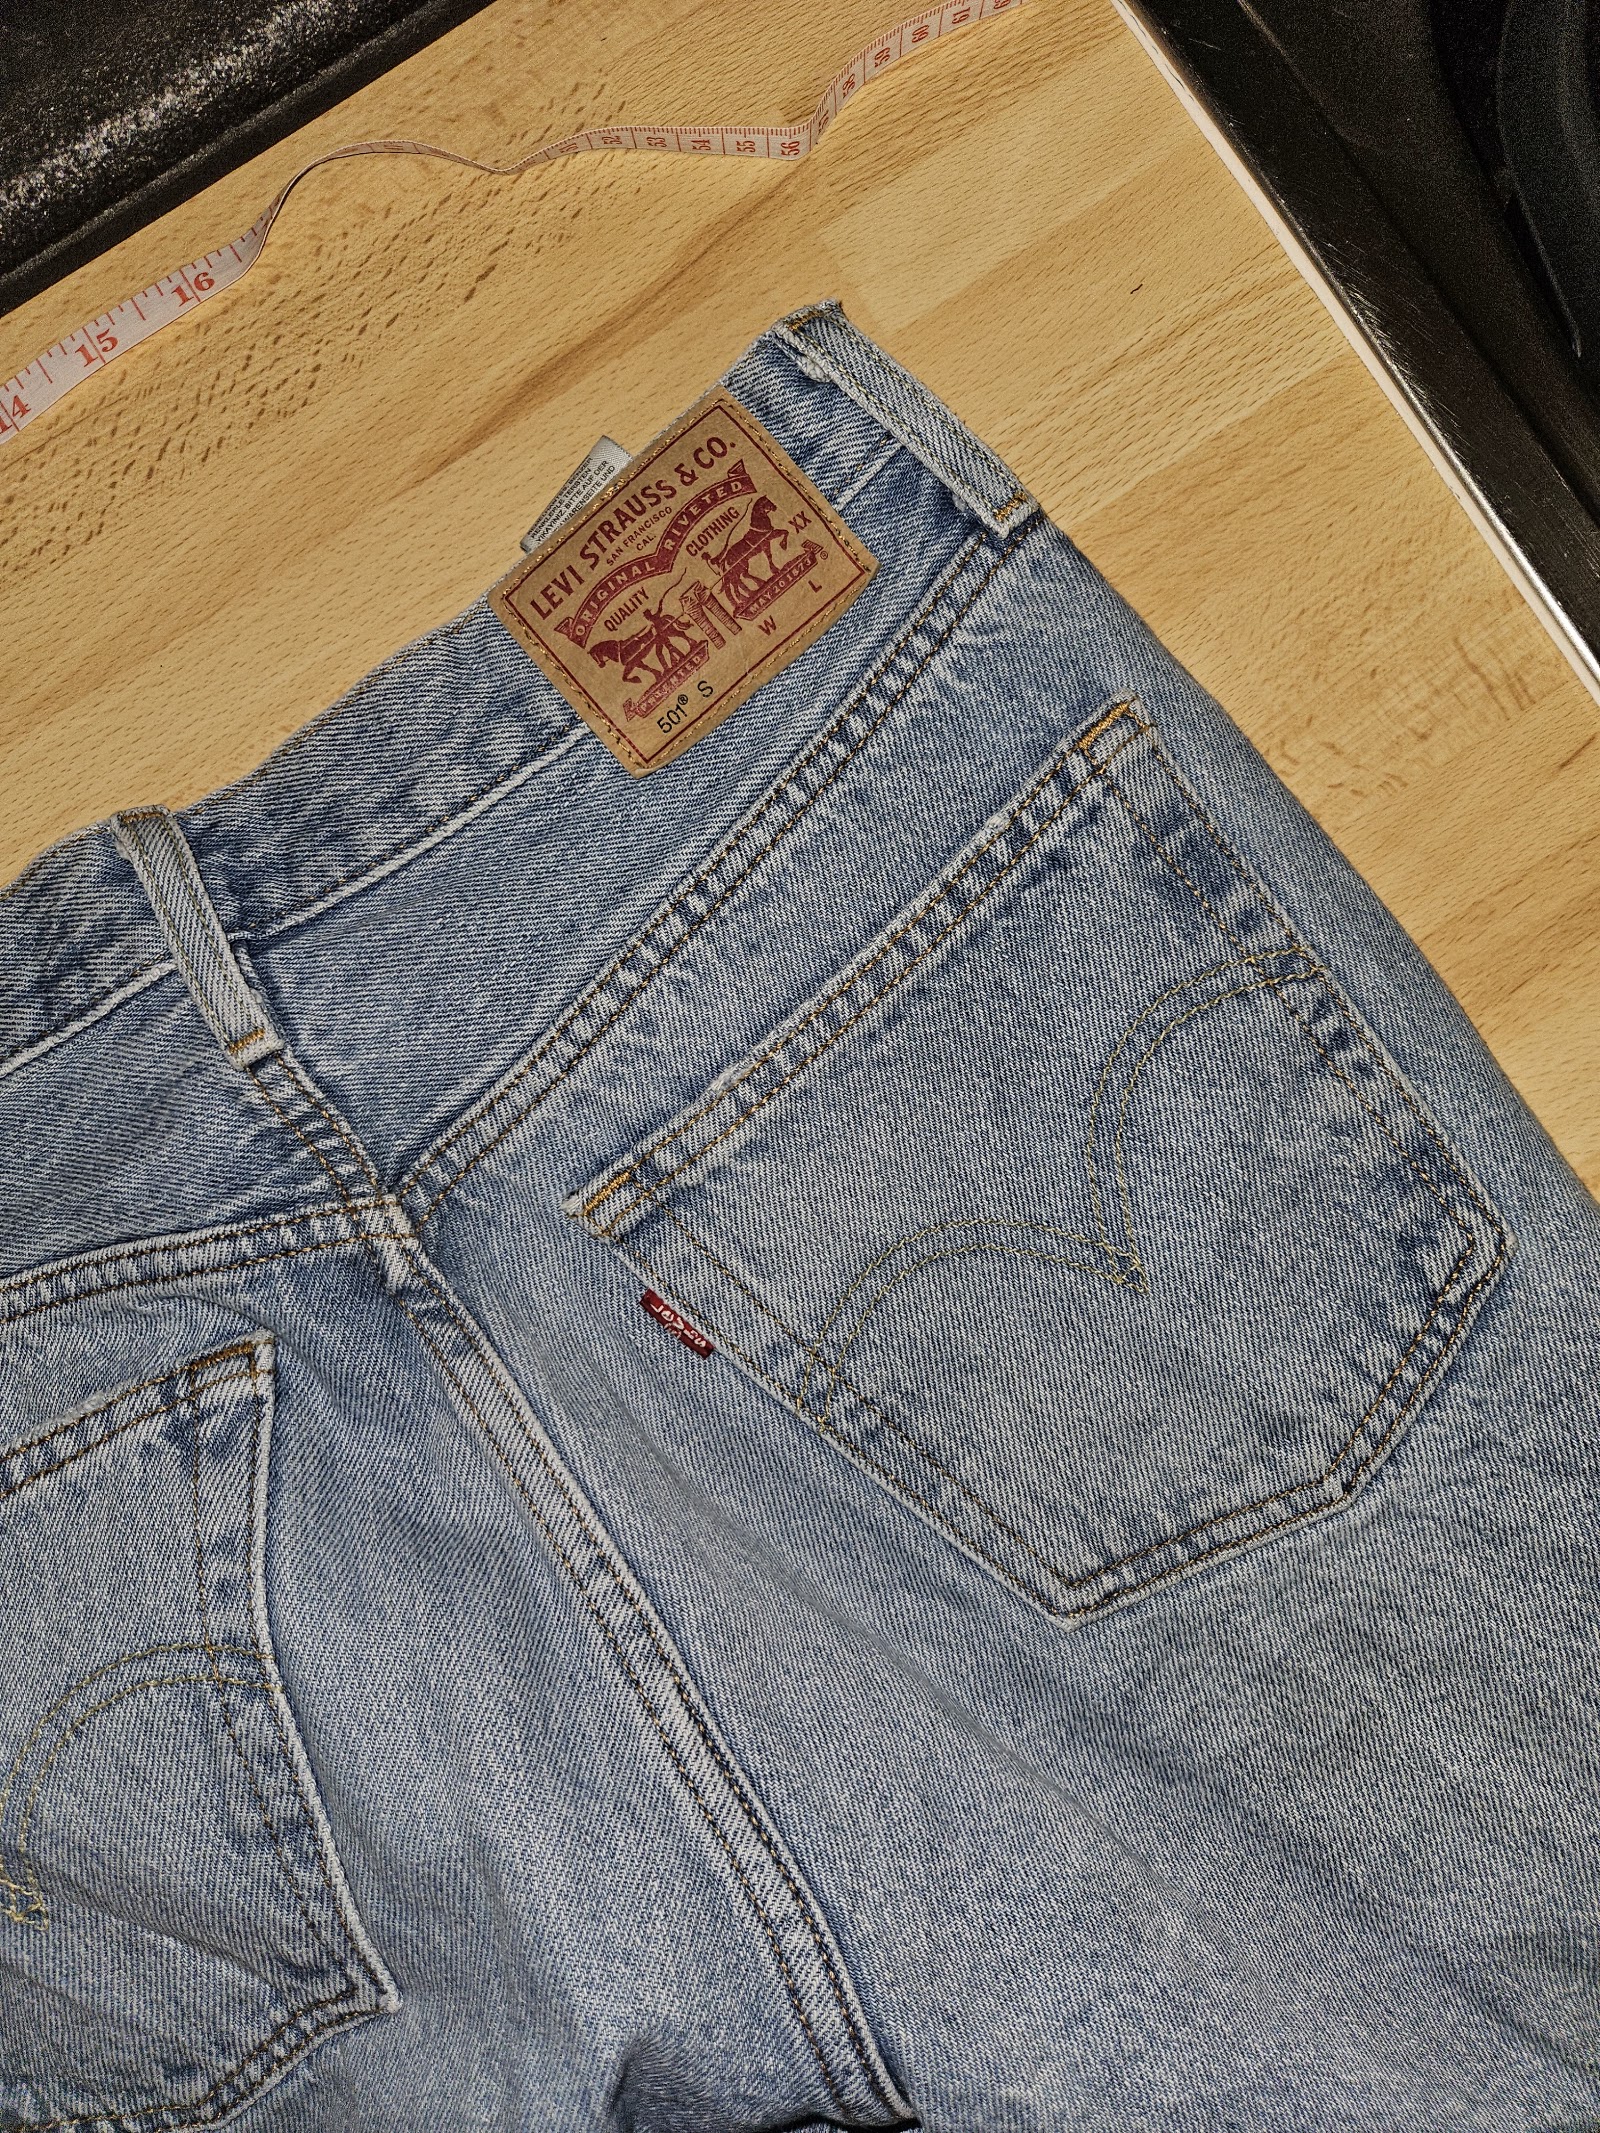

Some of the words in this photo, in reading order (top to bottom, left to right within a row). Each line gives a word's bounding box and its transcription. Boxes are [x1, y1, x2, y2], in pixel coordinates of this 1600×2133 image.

[951, 7, 971, 24] 61
[912, 24, 930, 43] 60
[874, 47, 891, 68] 59
[842, 73, 855, 99] 58
[646, 137, 667, 147] 53
[691, 139, 711, 151] 54
[736, 140, 756, 153] 55
[780, 140, 800, 156] 56
[171, 271, 215, 307] 16
[75, 328, 118, 367] 15
[563, 467, 592, 499] TERSTEN
[601, 465, 616, 482] UND
[565, 488, 583, 510] BITTE
[583, 476, 595, 491] AUF
[593, 460, 609, 477] DER
[530, 565, 585, 620] LEVI
[580, 479, 677, 571] STRAUSS
[674, 463, 699, 486] &
[693, 436, 736, 469] CO.
[685, 506, 740, 557] CLOTHING
[788, 510, 812, 534] XX
[606, 547, 624, 566] SAN
[623, 506, 673, 548] FRANCISCO
[636, 535, 657, 551] CAL.
[575, 561, 656, 636] ORIGINAL
[663, 482, 743, 551] RIVETED
[749, 591, 773, 614] MAY
[772, 580, 786, 594] 20
[786, 558, 812, 582] 1873
[808, 580, 822, 593] L
[603, 586, 649, 632] QUALITY
[758, 615, 777, 636] W
[697, 680, 714, 698] S
